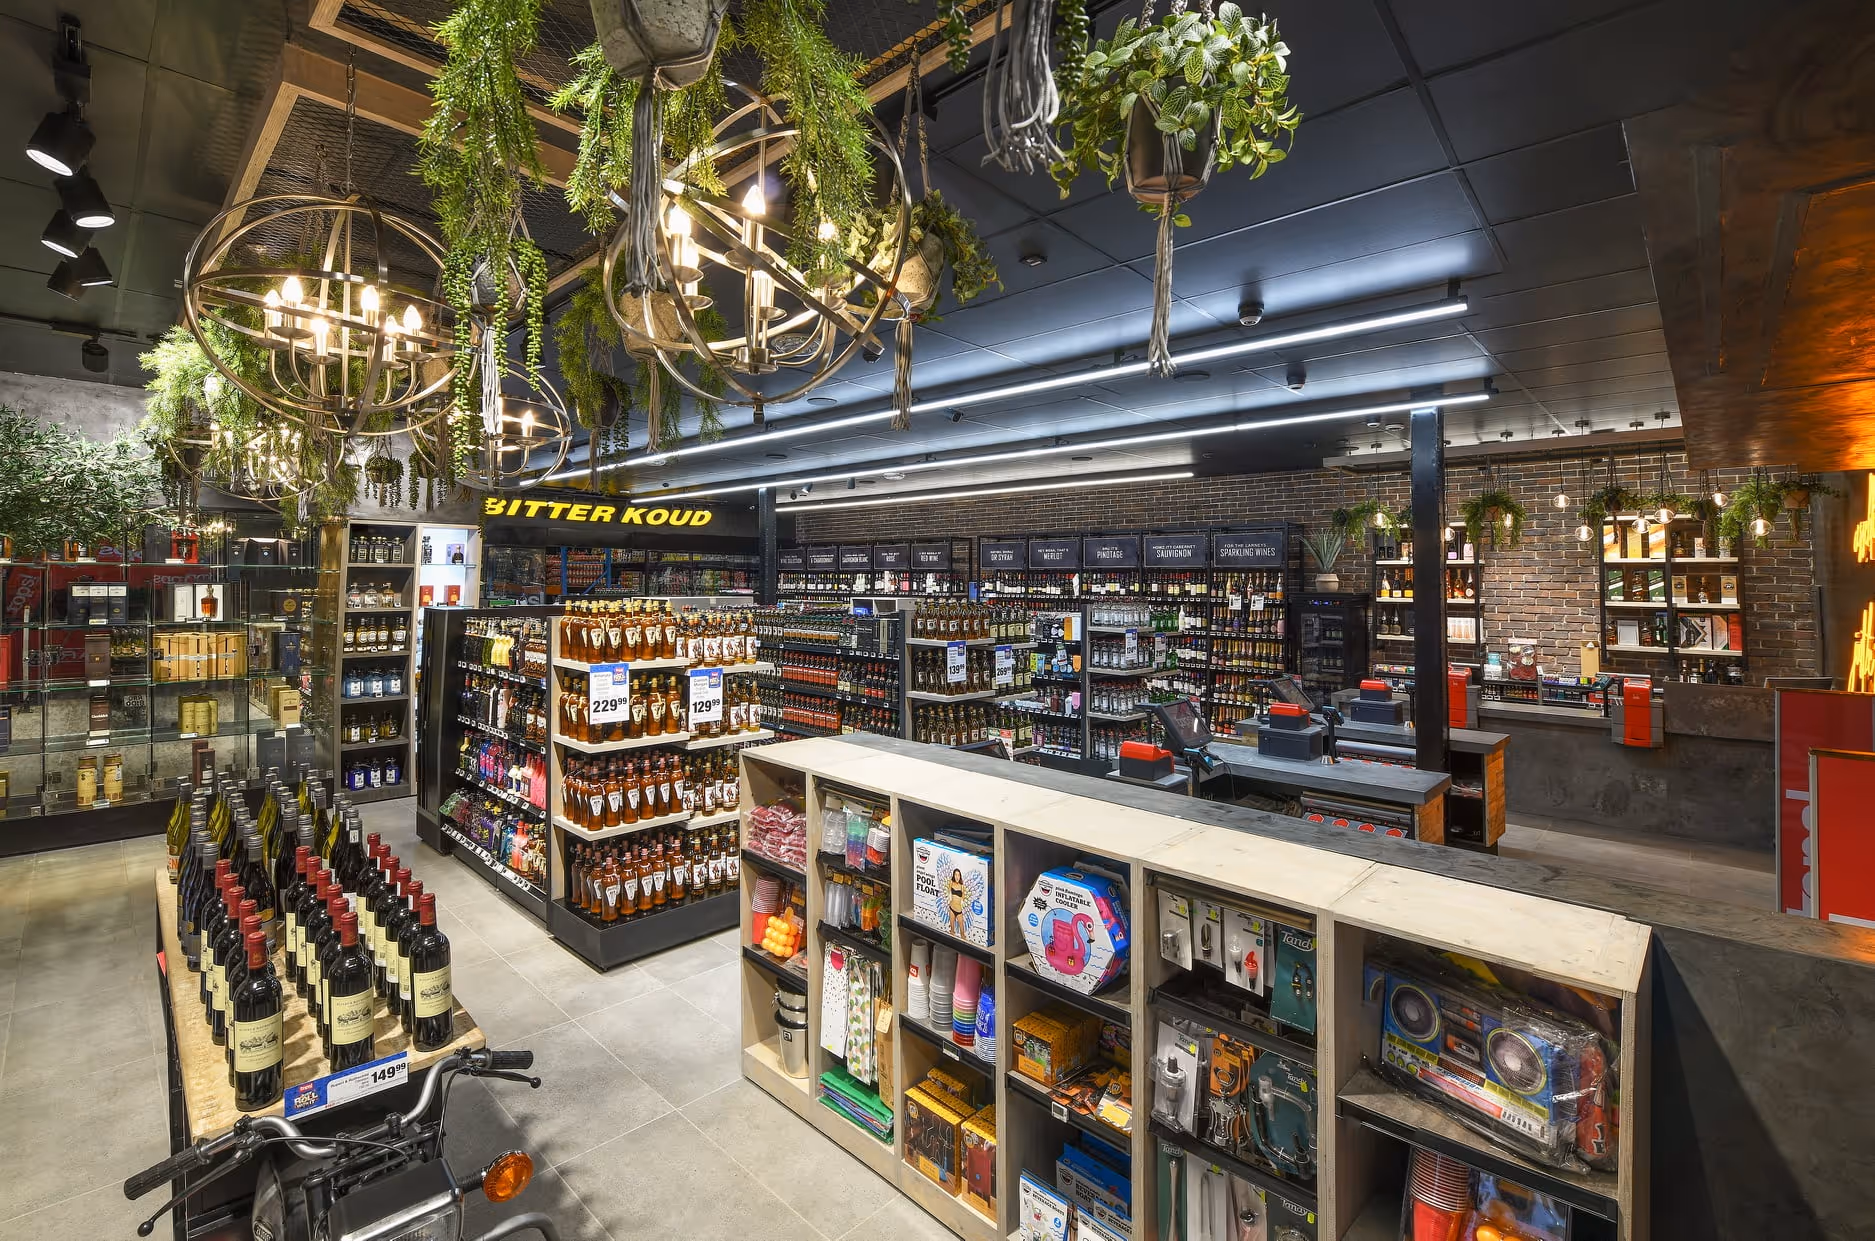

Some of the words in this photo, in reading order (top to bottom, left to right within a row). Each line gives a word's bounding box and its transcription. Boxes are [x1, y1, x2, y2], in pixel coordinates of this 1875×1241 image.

[485, 497, 615, 522] BITTER
[621, 507, 712, 526] KOUD
[1043, 552, 1063, 560] MERLOT
[1096, 550, 1124, 559] PINOTAGE
[1156, 549, 1192, 558] SAUVIGNON
[1220, 548, 1254, 557] SPARKLING
[1255, 547, 1276, 556] WINES
[592, 698, 618, 713] 229
[691, 700, 712, 714] 129
[916, 874, 936, 888] POOL
[916, 882, 939, 897] FLOAT
[1055, 891, 1091, 908] INFLATABLE
[1055, 898, 1079, 910] COOLER
[370, 1065, 396, 1084] 149
[395, 1062, 406, 1072] 99
[1282, 1197, 1310, 1216] Tandy
